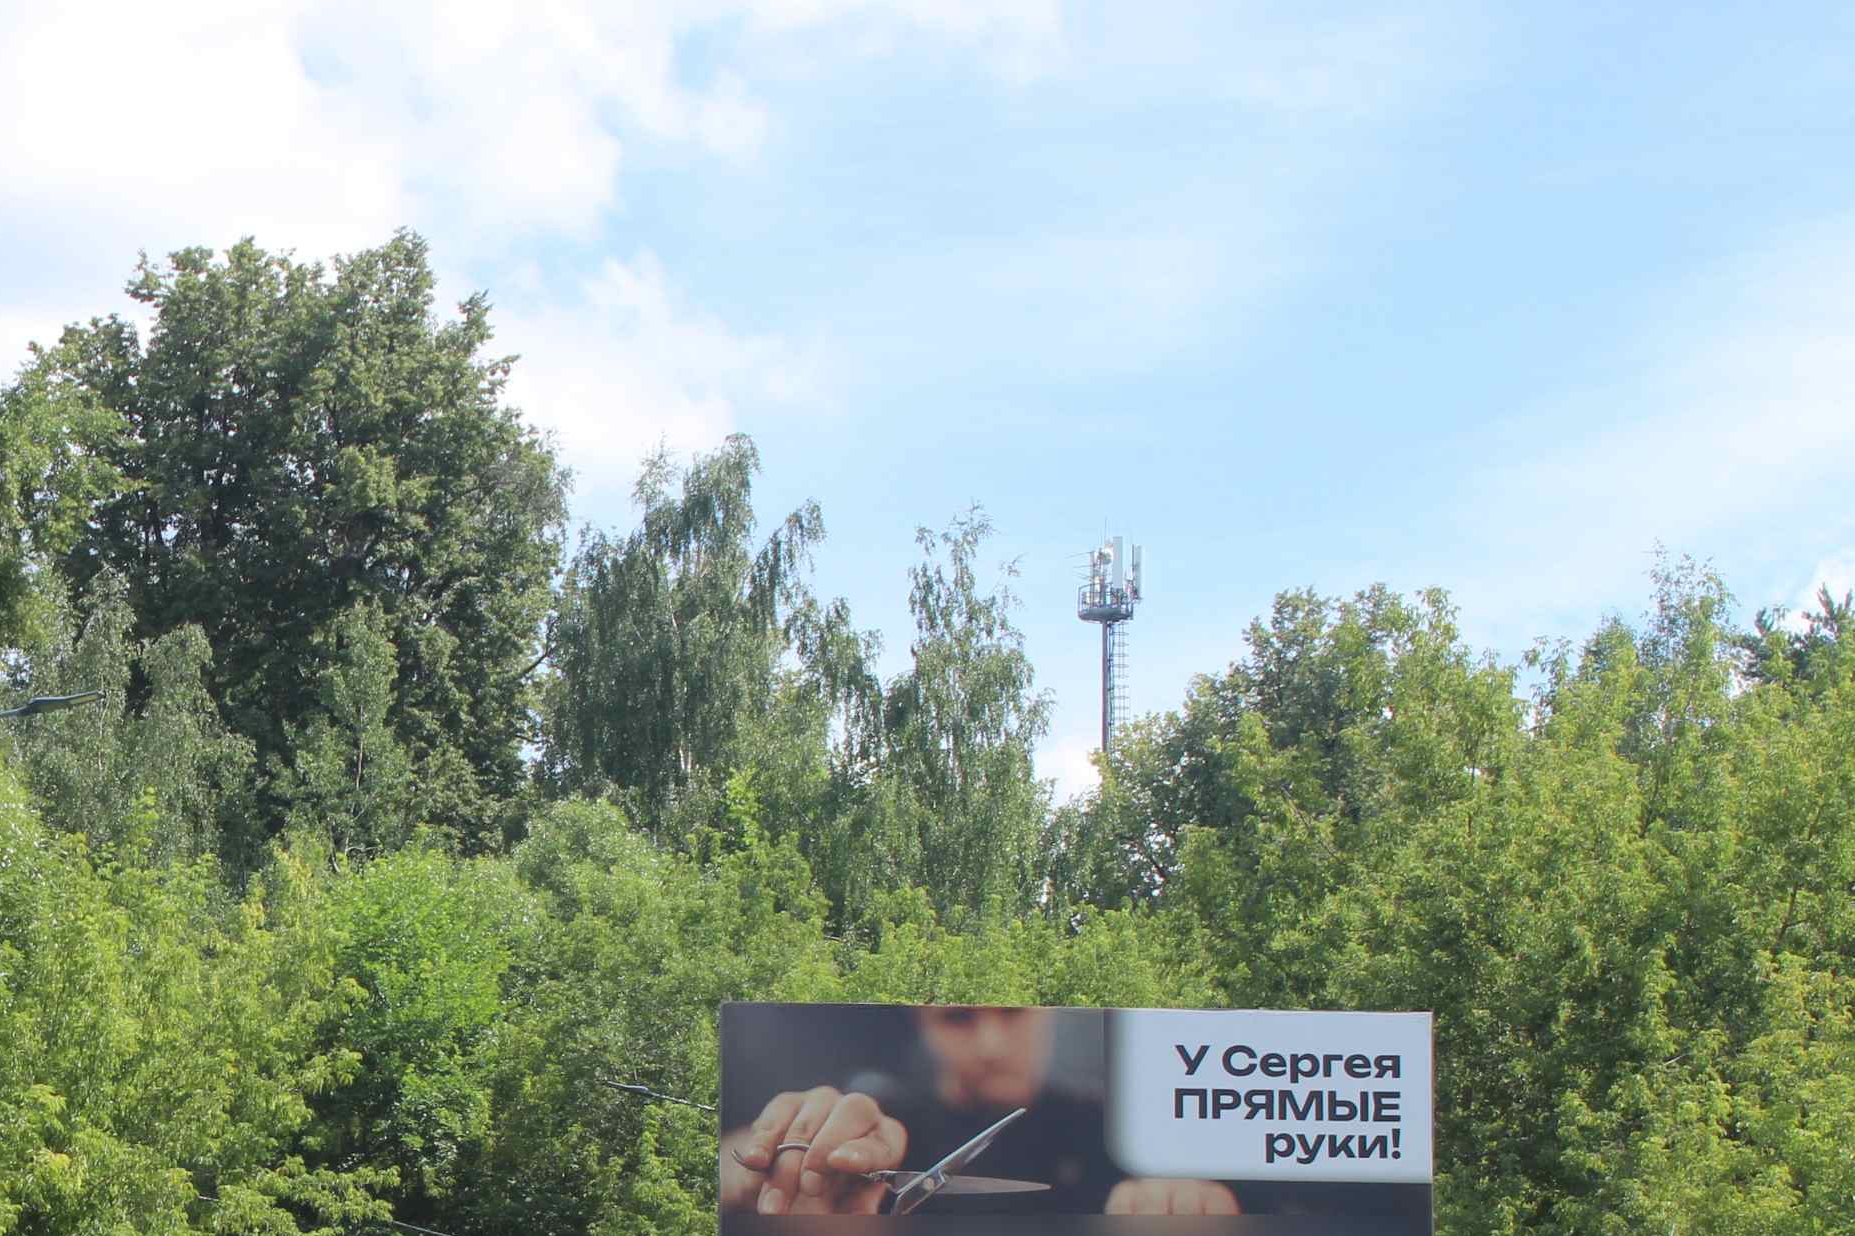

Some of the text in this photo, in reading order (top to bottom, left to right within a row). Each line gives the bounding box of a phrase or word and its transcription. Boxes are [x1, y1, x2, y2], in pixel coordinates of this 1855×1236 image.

[1175, 1044, 1402, 1084] У Сергея
[1174, 1087, 1402, 1122] ПРЯМЫЕ
[1265, 1128, 1402, 1165] руки!
